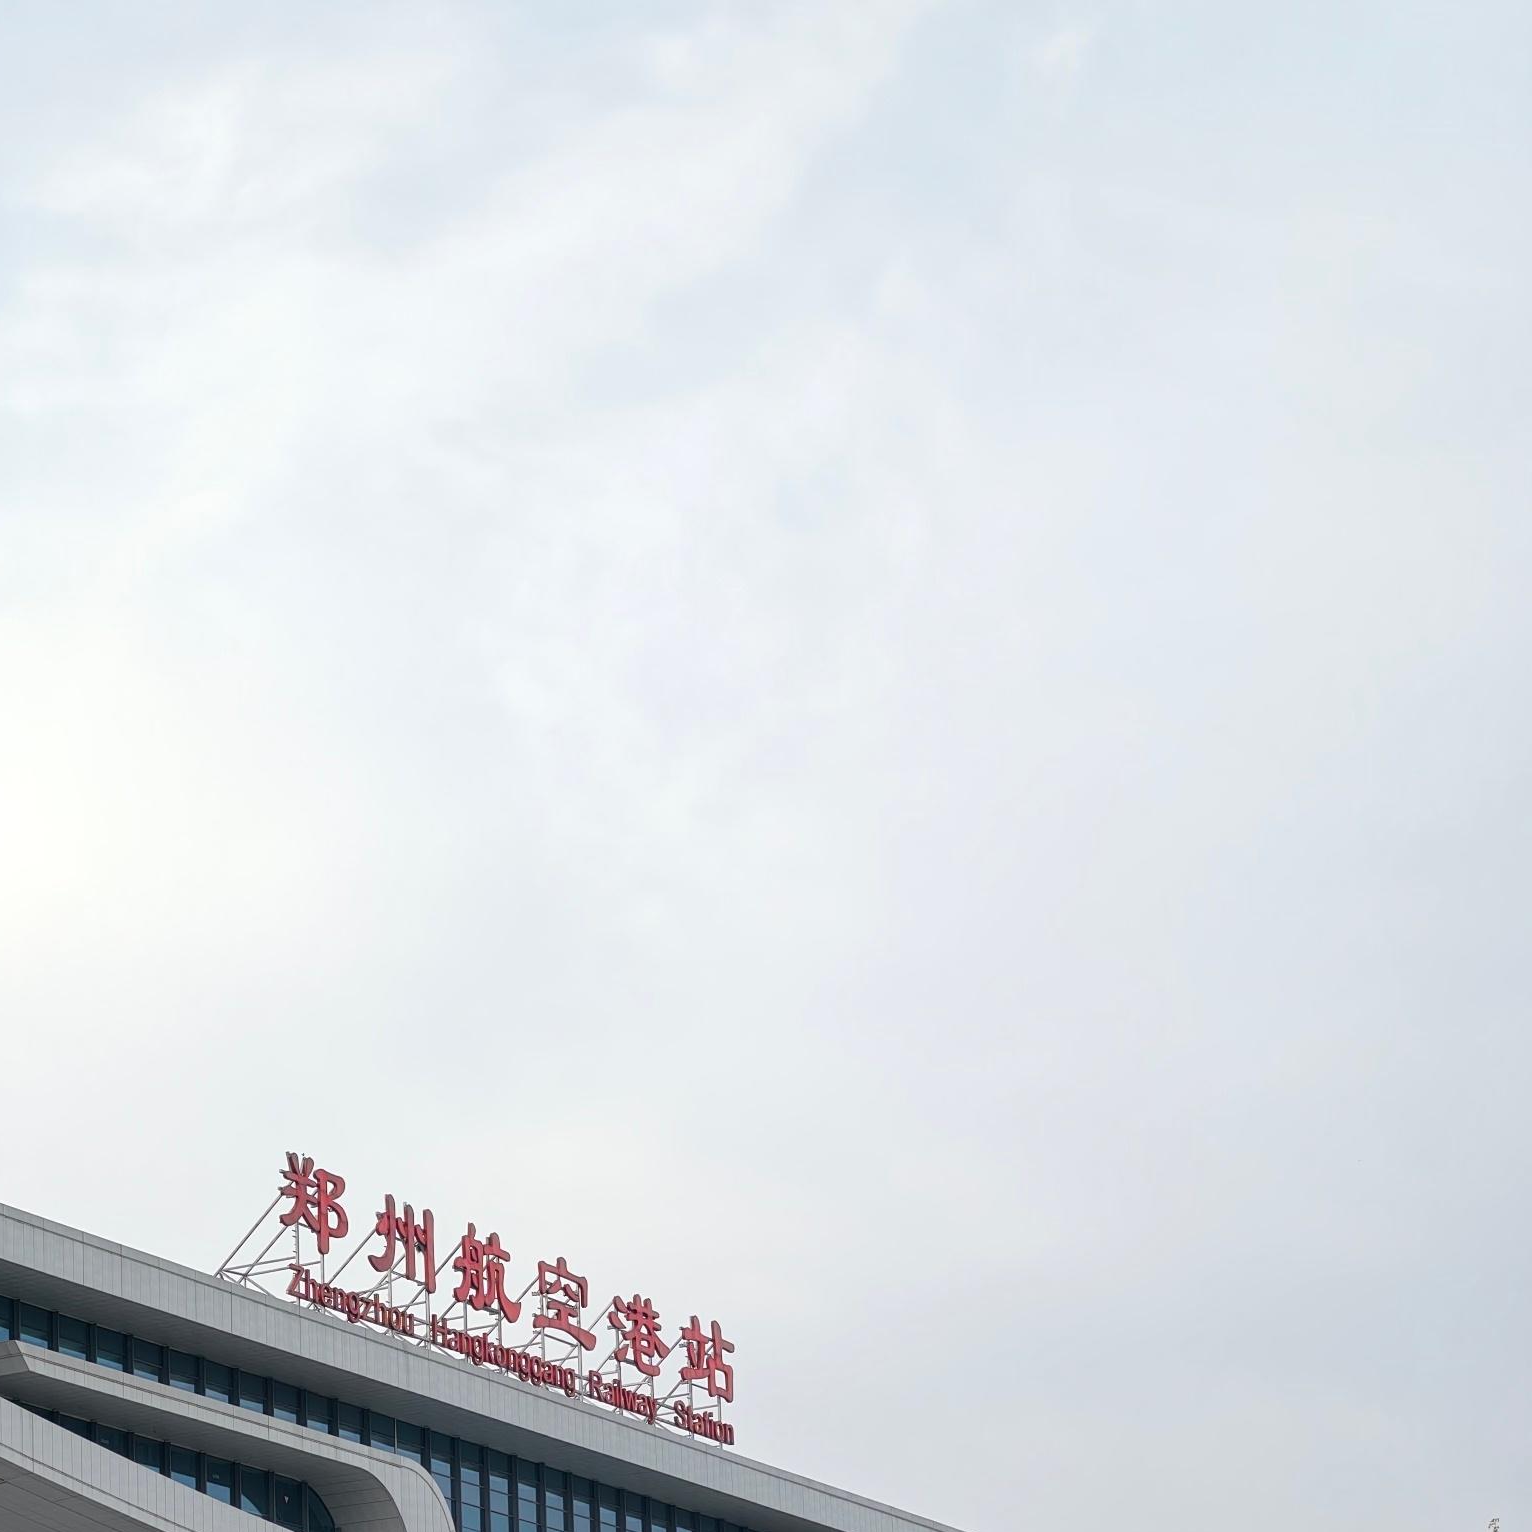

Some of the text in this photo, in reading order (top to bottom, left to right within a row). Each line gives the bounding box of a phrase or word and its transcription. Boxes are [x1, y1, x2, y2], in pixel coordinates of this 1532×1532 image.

[279, 1151, 734, 1402] 郑州航空港站
[286, 1263, 734, 1445] Zhengzhou Hangkonggang Railway Station
